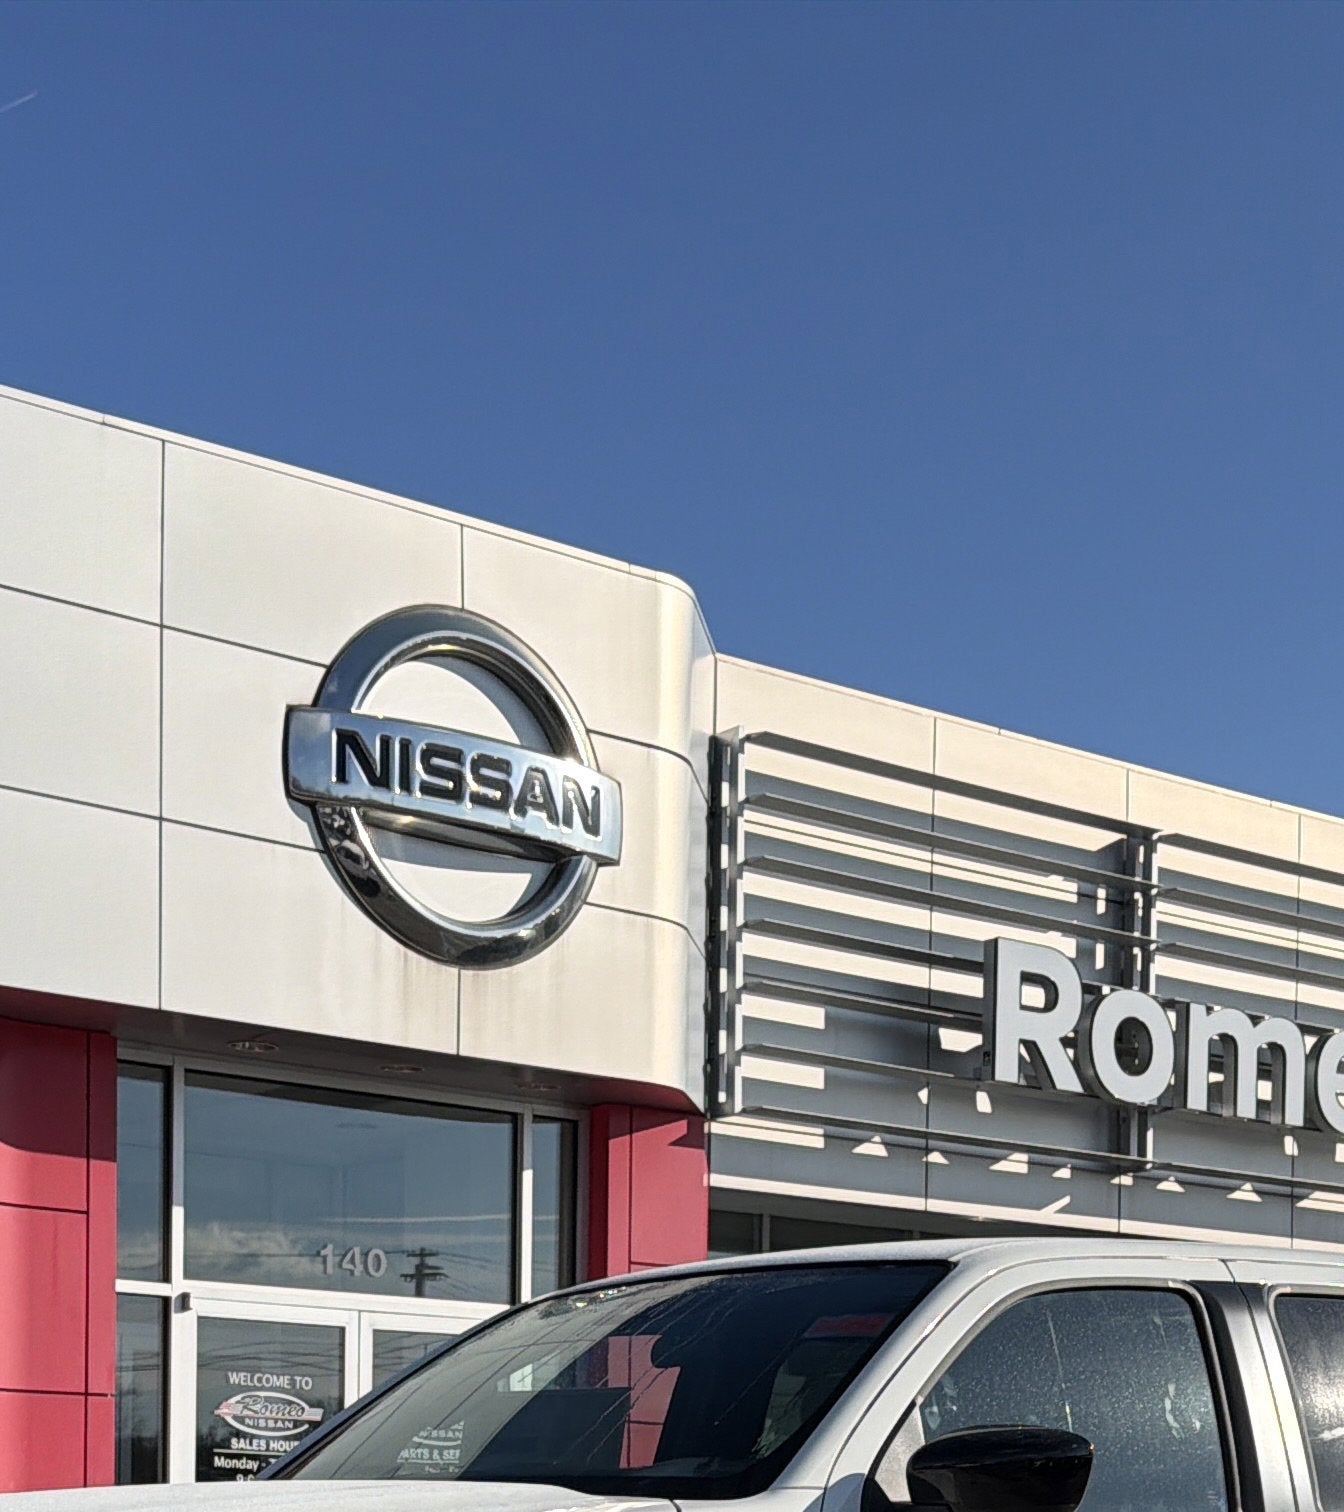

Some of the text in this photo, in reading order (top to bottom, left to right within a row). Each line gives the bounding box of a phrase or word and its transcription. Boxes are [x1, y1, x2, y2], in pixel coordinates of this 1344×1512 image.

[331, 728, 604, 842] NISSAN
[319, 1244, 388, 1278] 140
[228, 1371, 313, 1391] WELCOME TO
[236, 1394, 306, 1417] Romeo
[244, 1418, 294, 1429] NISSAN
[230, 1437, 301, 1452] SALES HOU
[213, 1456, 260, 1472] Monday
